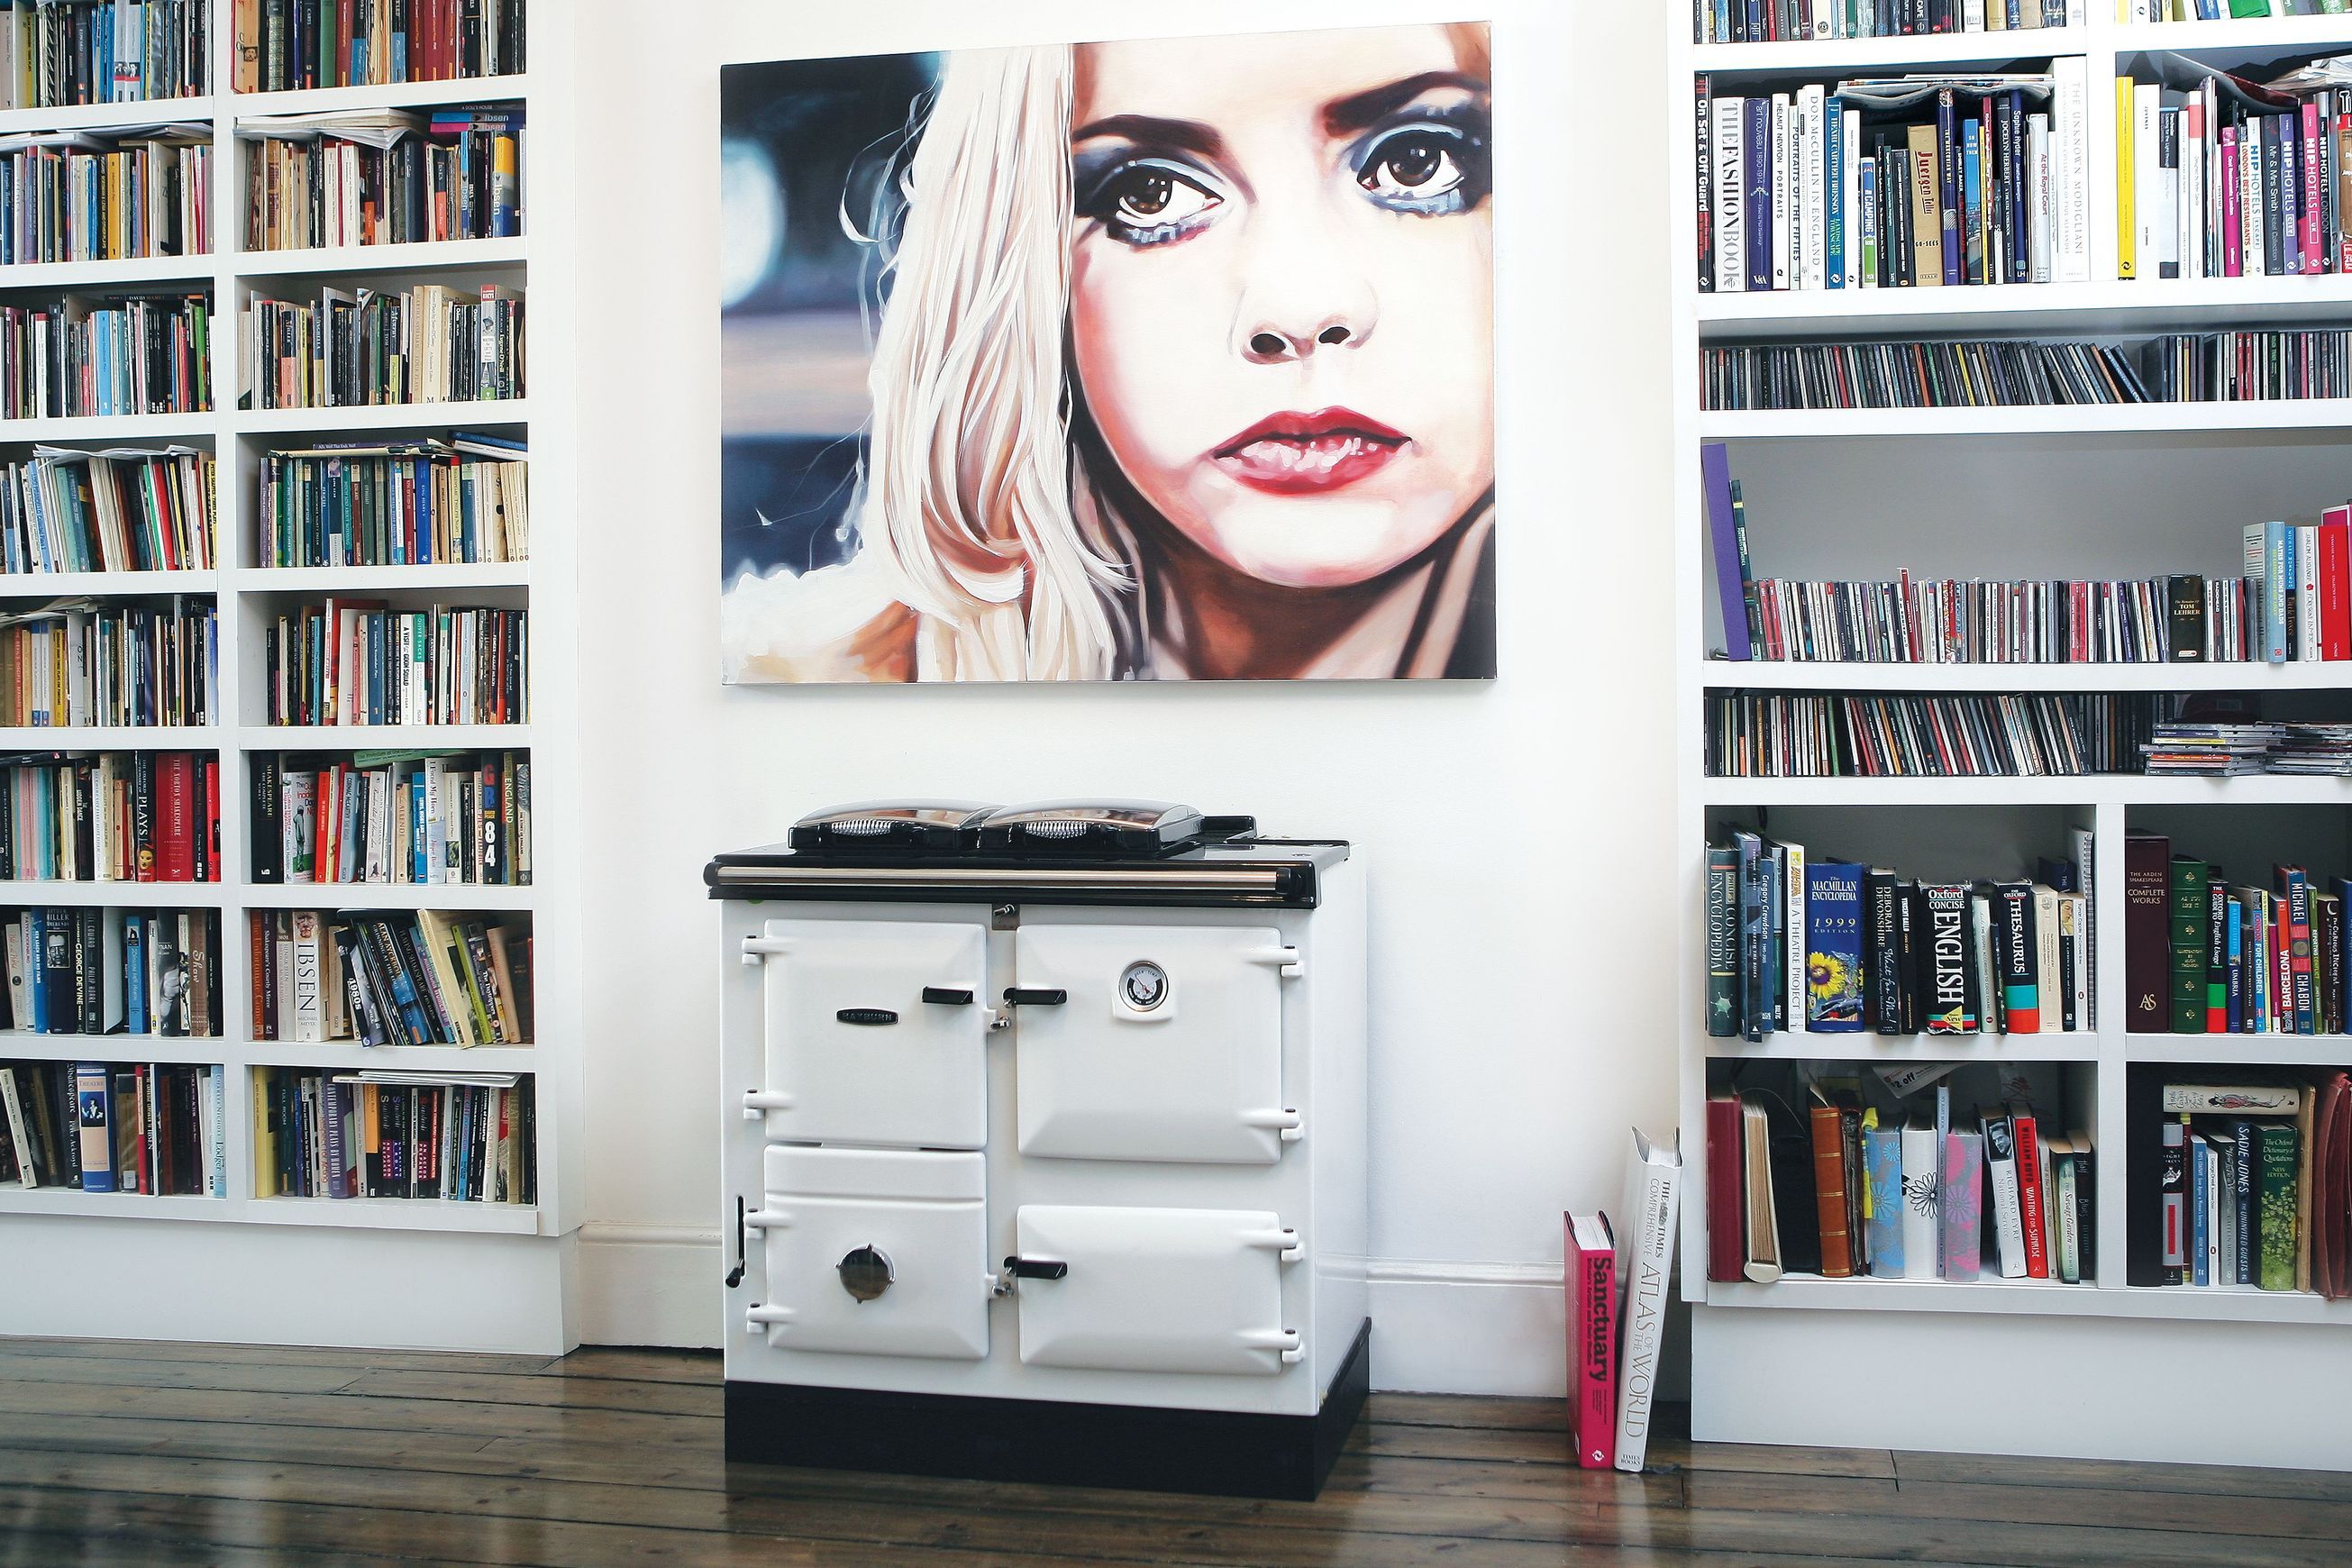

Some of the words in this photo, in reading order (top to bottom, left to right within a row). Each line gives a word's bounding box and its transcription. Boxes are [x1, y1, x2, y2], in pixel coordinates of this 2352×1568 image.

[2072, 81, 2080, 105] THE
[1698, 100, 1708, 116] On
[1810, 96, 1819, 122] DON
[2013, 111, 2021, 134] Sophie
[1699, 119, 1708, 141] Set
[2001, 120, 2010, 150] JOCELYN
[2073, 112, 2082, 174] UNKNOWN
[2013, 136, 2021, 156] Ryder
[2269, 146, 2277, 159] Mr
[2284, 141, 2293, 168] HIP
[2306, 138, 2315, 165] HIP
[1699, 155, 1709, 172] Off
[1918, 150, 1933, 196] Juergen
[492, 184, 503, 215] Ibsen
[1700, 176, 1709, 212] Guard
[1793, 187, 1799, 199] OF
[1812, 191, 1819, 202] IN
[2252, 174, 2260, 214] HOTELS
[2284, 170, 2293, 211] HOTELS
[2307, 167, 2317, 208] HOTELS
[1864, 195, 1874, 232] CAMPING
[1923, 198, 1933, 215] Teller
[2074, 181, 2083, 254] MODIGLIANI
[344, 777, 352, 795] CORMAC
[504, 778, 513, 823] ENGLAND
[138, 797, 148, 835] PLAYS
[344, 797, 352, 819] McCARTHY
[1761, 875, 1769, 903] Gregory
[1811, 880, 1856, 890] MACMILLAN
[1811, 891, 1857, 901] ENCYCLOPEDIA
[1928, 889, 1964, 900] Oxford
[2128, 889, 2165, 897] COMPLETE
[1884, 887, 1892, 932] DEBORAH
[1928, 900, 1965, 909] CONCISE
[2293, 883, 2303, 921] MICHAEL
[1710, 872, 1722, 969] ENCYCLOPEDIA
[1813, 917, 1856, 929] 1999
[1876, 887, 1884, 947] DEVONSHIRE
[1726, 907, 1736, 969] CONCISE
[1792, 921, 1800, 963] THEATRE
[2010, 898, 2025, 973] THESAURUS
[75, 944, 83, 975] GEORGE
[191, 950, 205, 982] Shaw
[1884, 949, 1894, 975] Wait
[1934, 911, 1964, 1003] ENGLISH
[297, 944, 316, 1012] IBSEN
[1792, 967, 1800, 1009] PROJECT
[1885, 978, 1895, 994] for
[2281, 950, 2289, 1007] BARCELONA
[348, 979, 361, 1009] 1980s
[483, 983, 497, 1015] Daytrippers
[2297, 975, 2310, 1011] CHABON
[1885, 998, 1896, 1022] Me!
[329, 1130, 339, 1147] PLAYS
[2022, 1126, 2032, 1160] WILLIAM
[2238, 1127, 2249, 1157] SADIE
[2263, 1146, 2288, 1154] Dictionary
[215, 1142, 223, 1171] Lodger
[330, 1157, 342, 1178] WOMEN
[2024, 1162, 2034, 1182] BOYD
[2238, 1161, 2249, 1192] JONES
[1660, 1181, 1672, 1201] THE
[2006, 1170, 2016, 1214] RICHARD
[2026, 1187, 2036, 1217] WAITING
[2065, 1192, 2074, 1217] Savage
[1644, 1179, 1659, 1255] COMPREHENSIVE
[2079, 1199, 2089, 1217] Blues
[2001, 1212, 2010, 1237] Service
[2065, 1217, 2074, 1243] Garden
[2240, 1211, 2248, 1244] UNINVITED
[1655, 1225, 1665, 1258] TIMES
[2029, 1229, 2040, 1257] SUNRISE
[2240, 1247, 2248, 1272] GUESTS
[1636, 1262, 1661, 1332] ATLAS
[1586, 1258, 1612, 1381] Sanctuary
[1633, 1333, 1645, 1351] THE
[1645, 1336, 1654, 1349] OF
[1625, 1352, 1653, 1437] WORLD
